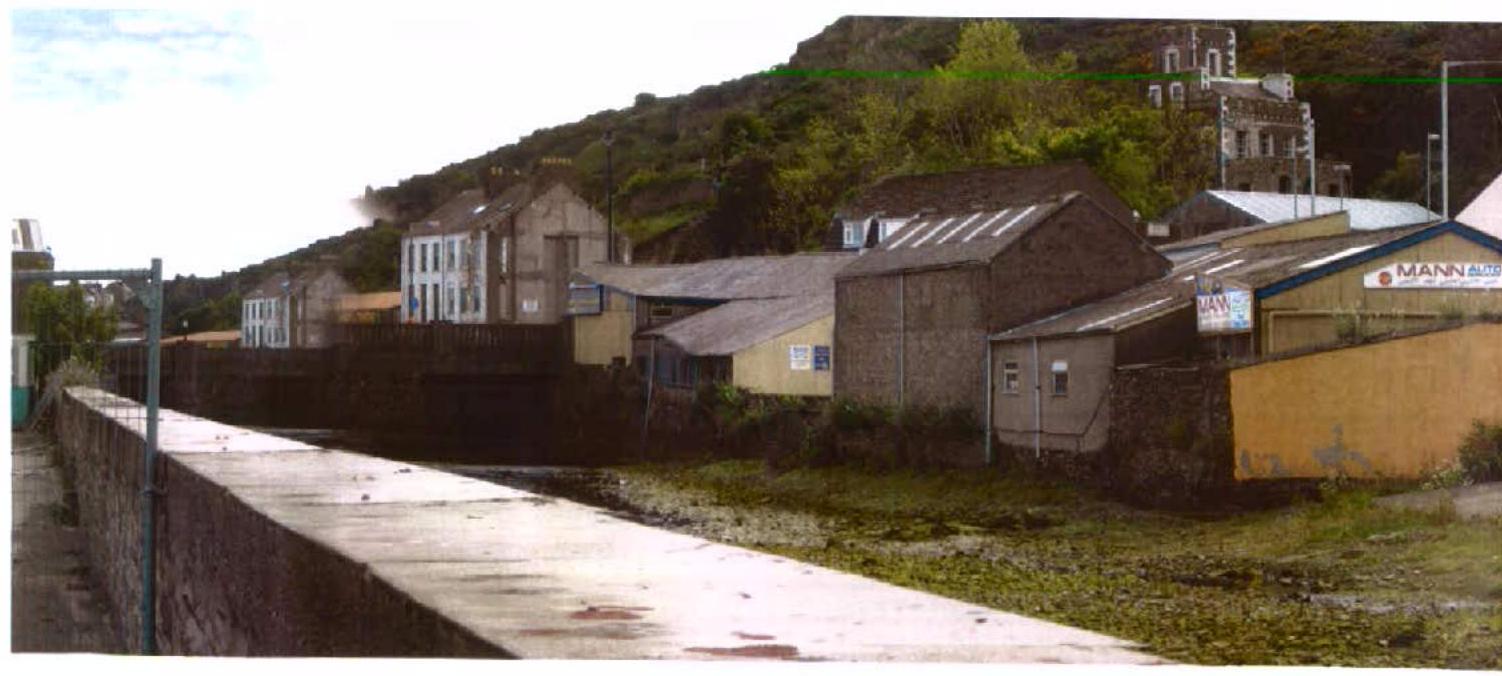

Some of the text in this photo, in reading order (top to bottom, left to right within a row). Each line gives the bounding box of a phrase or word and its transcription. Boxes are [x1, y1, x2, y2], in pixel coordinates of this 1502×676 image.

[1396, 263, 1502, 277] MANN AUTO
[1198, 295, 1231, 312] MANN
